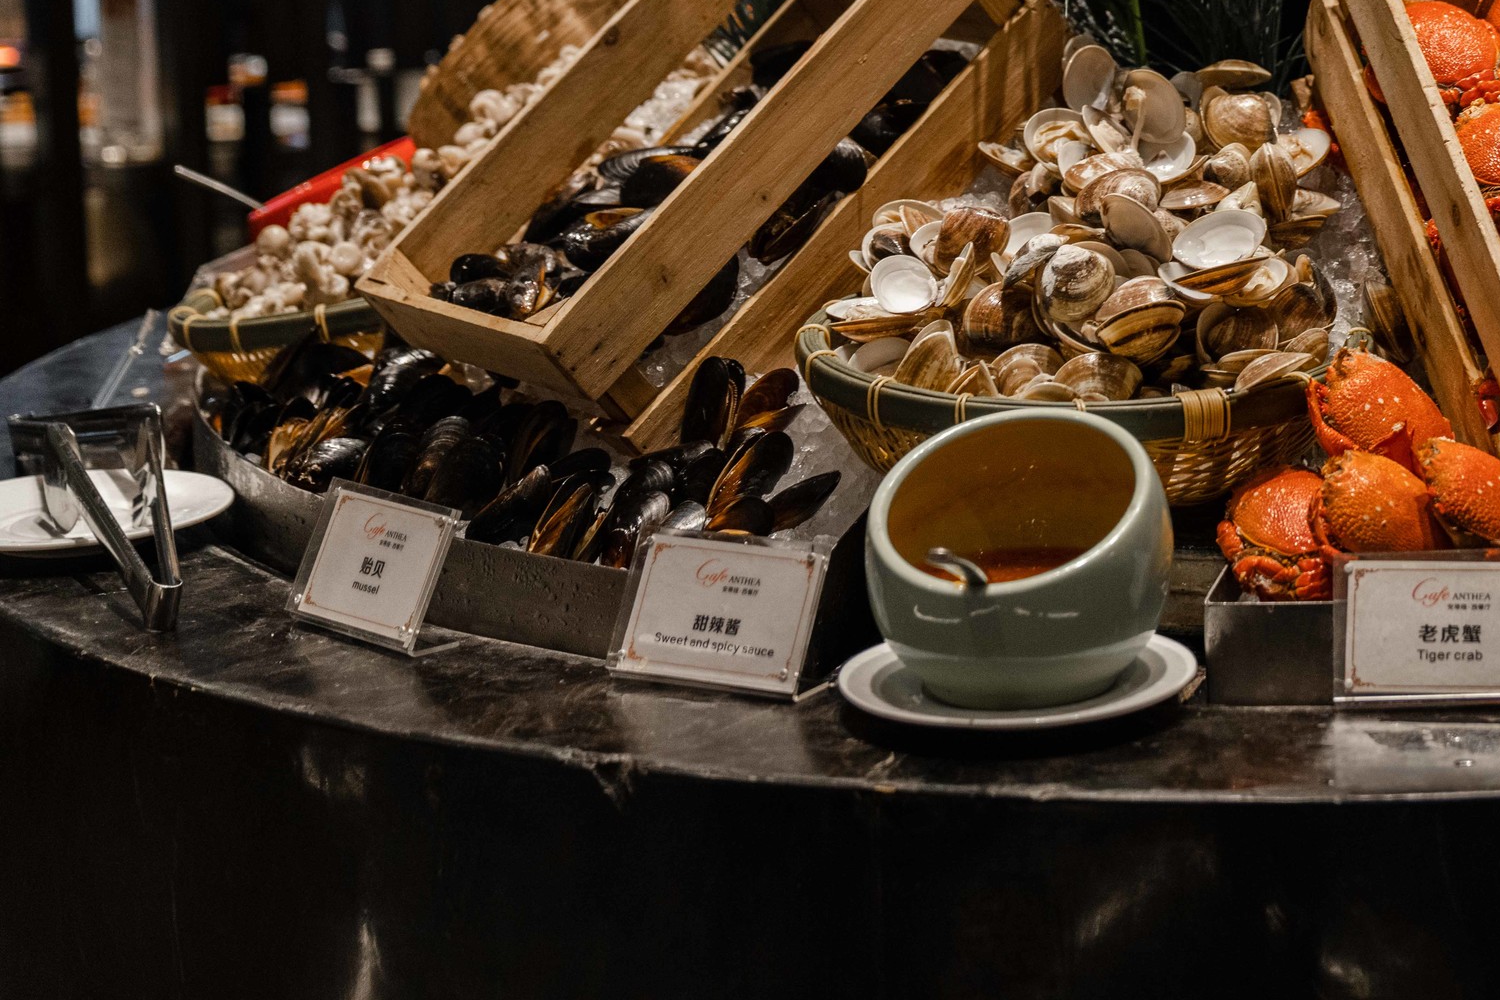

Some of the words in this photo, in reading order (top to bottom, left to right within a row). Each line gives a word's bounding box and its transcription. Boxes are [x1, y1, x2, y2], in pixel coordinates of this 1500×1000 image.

[352, 581, 380, 595] mussel
[728, 576, 761, 587] ANTHEA
[1452, 592, 1491, 600] ANTHEA
[692, 614, 741, 636] 甜辣酱
[1418, 624, 1481, 643] 老虎蟹
[654, 631, 688, 646] Sweet
[689, 638, 710, 649] and
[711, 642, 740, 656] spicy
[742, 646, 774, 657] sauce
[1417, 648, 1450, 663] Tiger
[1454, 649, 1483, 661] crab
